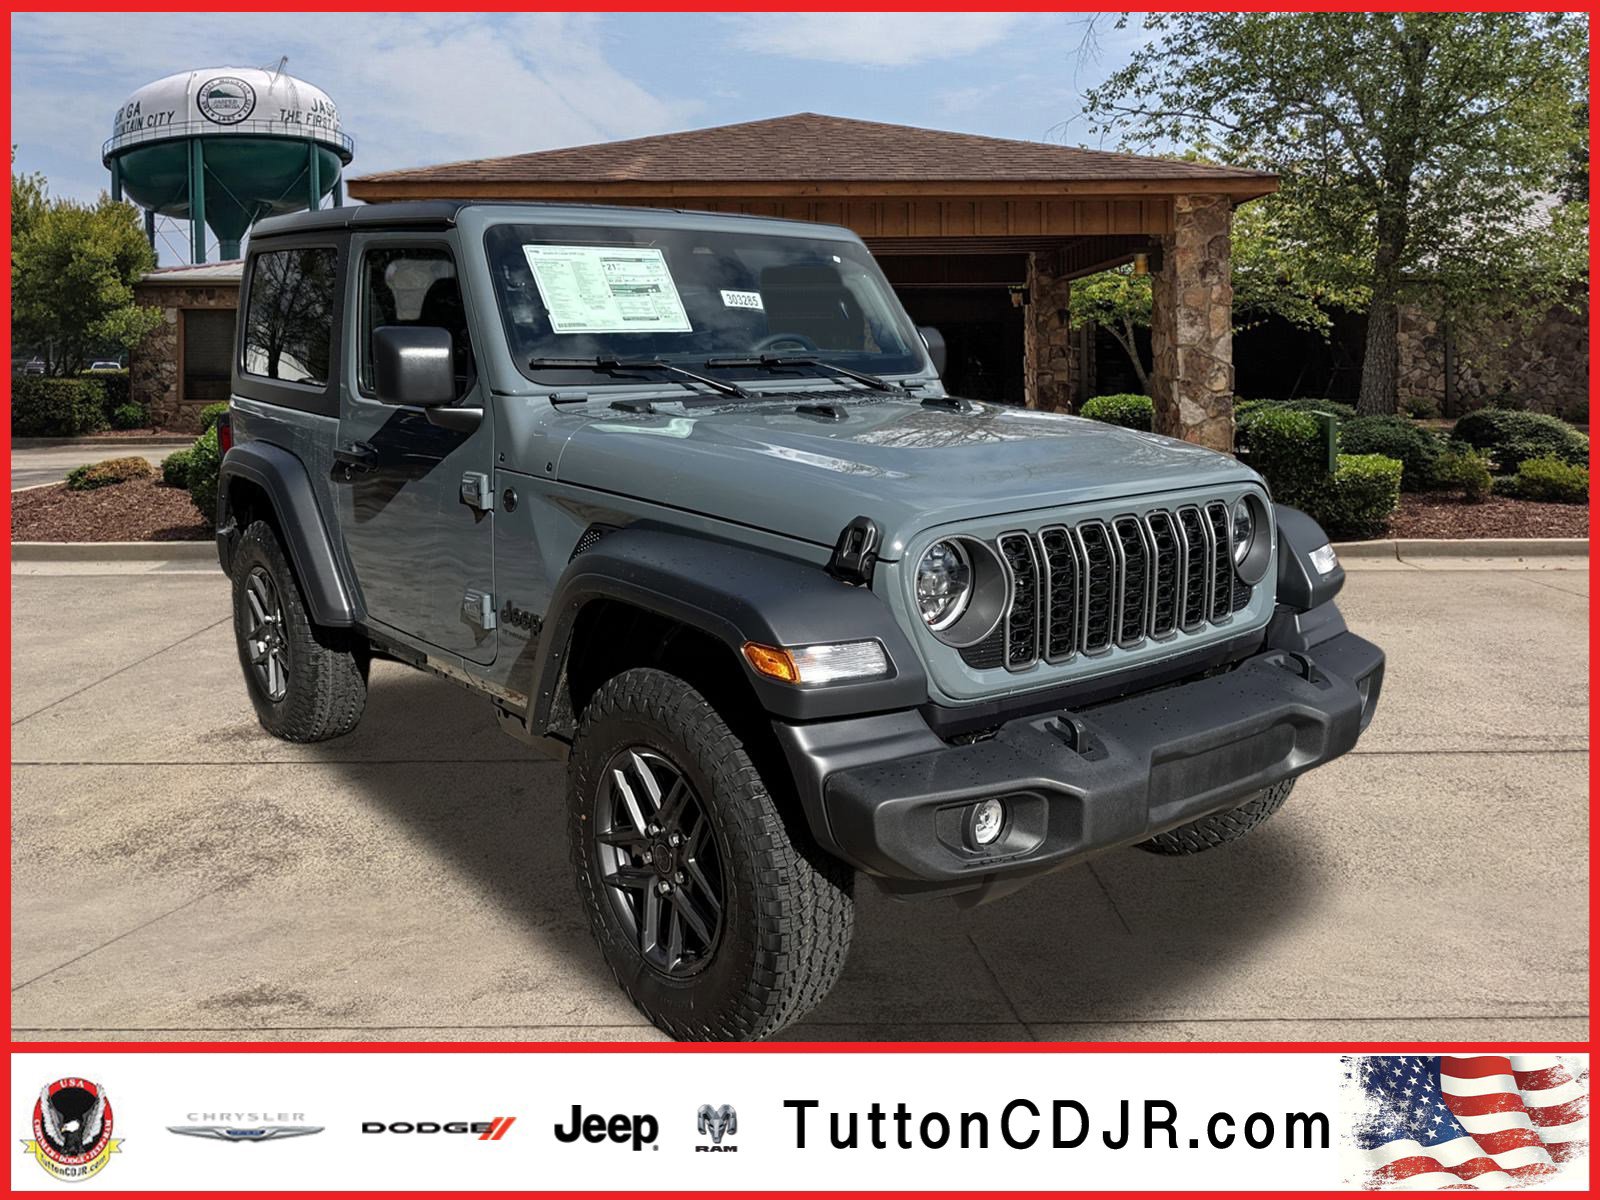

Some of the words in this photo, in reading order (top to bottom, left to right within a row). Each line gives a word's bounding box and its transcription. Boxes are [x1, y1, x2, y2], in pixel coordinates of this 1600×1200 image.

[127, 101, 141, 119] GA
[147, 110, 175, 127] CITY
[280, 109, 302, 123] THE
[306, 112, 332, 129] FIRST
[726, 293, 759, 307] 303285
[500, 600, 542, 636] Jeep
